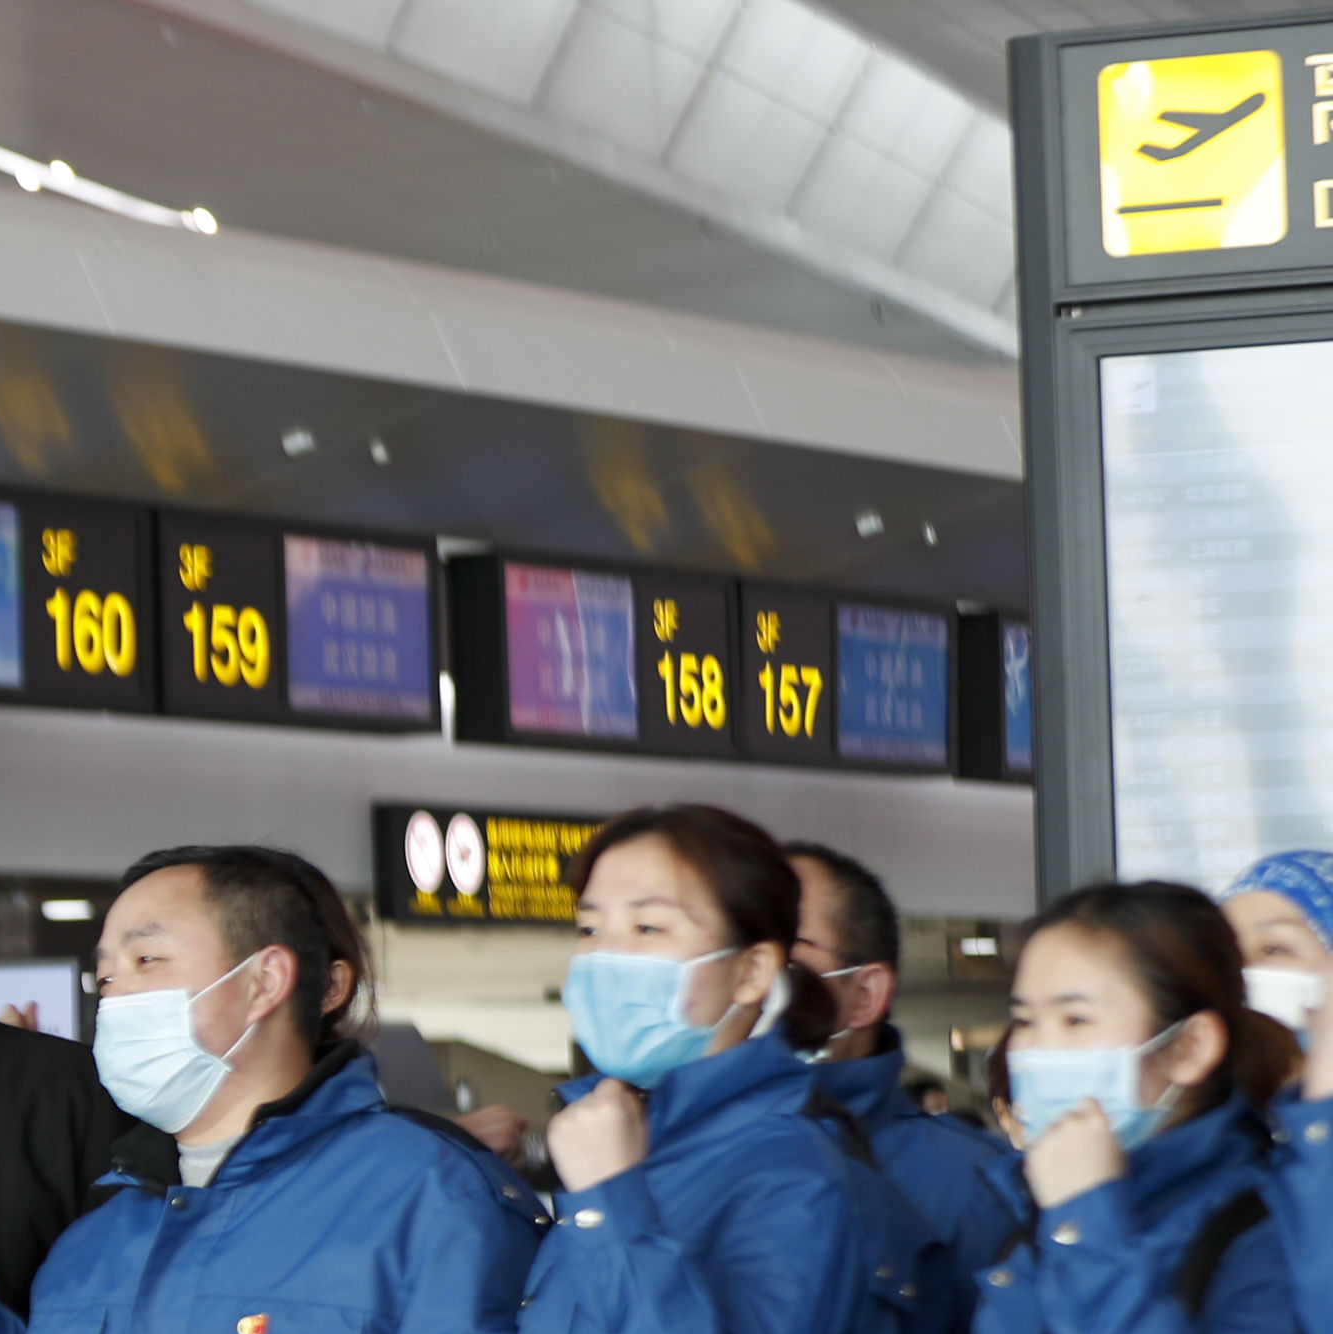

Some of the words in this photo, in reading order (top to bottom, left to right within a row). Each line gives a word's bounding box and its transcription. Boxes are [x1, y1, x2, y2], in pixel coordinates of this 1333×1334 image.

[41, 527, 78, 577] 3F
[178, 543, 214, 591] 3F
[44, 585, 138, 677] 160
[182, 599, 272, 690] 159
[656, 650, 727, 731] 158
[757, 662, 824, 738] 157
